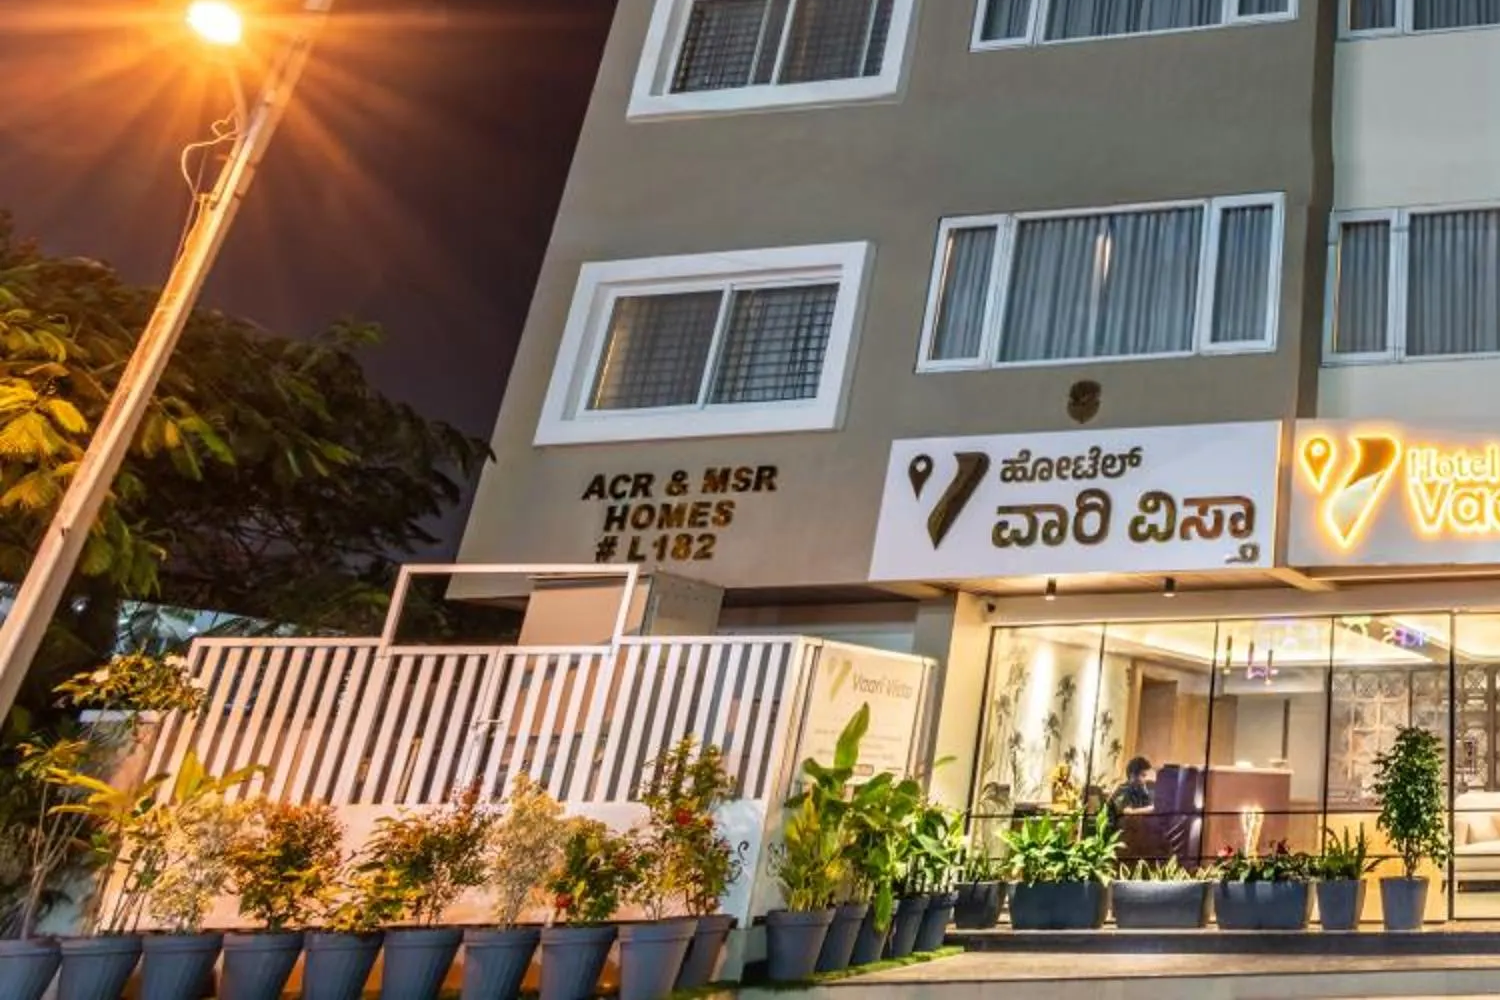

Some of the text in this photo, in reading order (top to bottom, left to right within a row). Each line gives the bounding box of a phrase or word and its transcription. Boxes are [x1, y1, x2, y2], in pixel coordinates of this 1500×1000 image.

[999, 446, 1143, 484] ಹೋಟೆಲ್
[1409, 447, 1500, 479] Hotel
[581, 465, 778, 500] ACR & MSR
[603, 500, 736, 532] HOMES
[991, 488, 1260, 564] ವಾರಿ ವಿಸ್ತಾ
[595, 533, 717, 563] # L182
